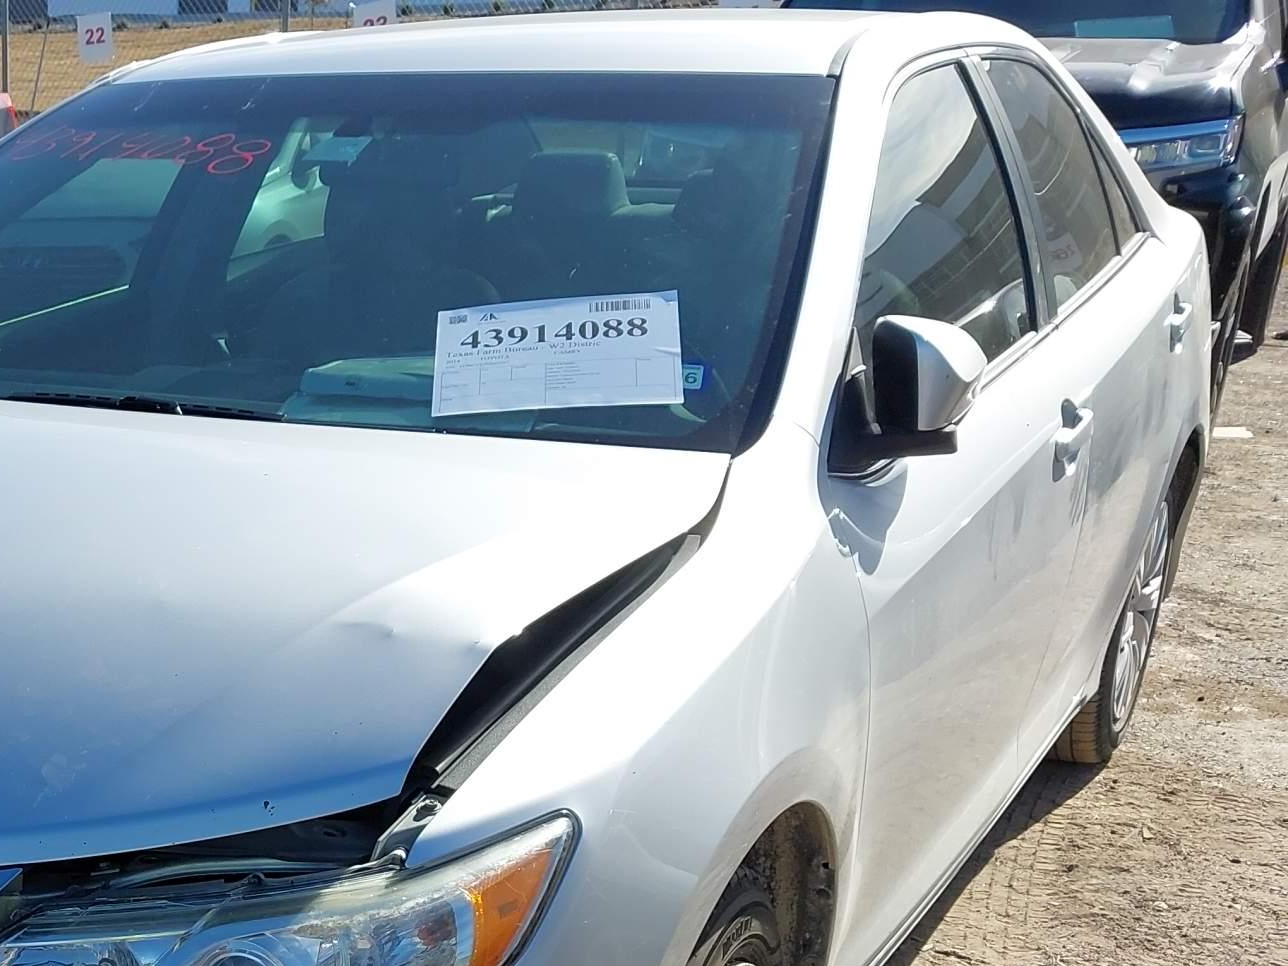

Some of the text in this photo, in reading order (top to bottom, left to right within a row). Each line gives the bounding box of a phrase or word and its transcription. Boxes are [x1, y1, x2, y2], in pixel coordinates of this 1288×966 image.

[85, 27, 105, 45] 22
[460, 317, 649, 349] 43914088
[685, 372, 697, 384] 6
